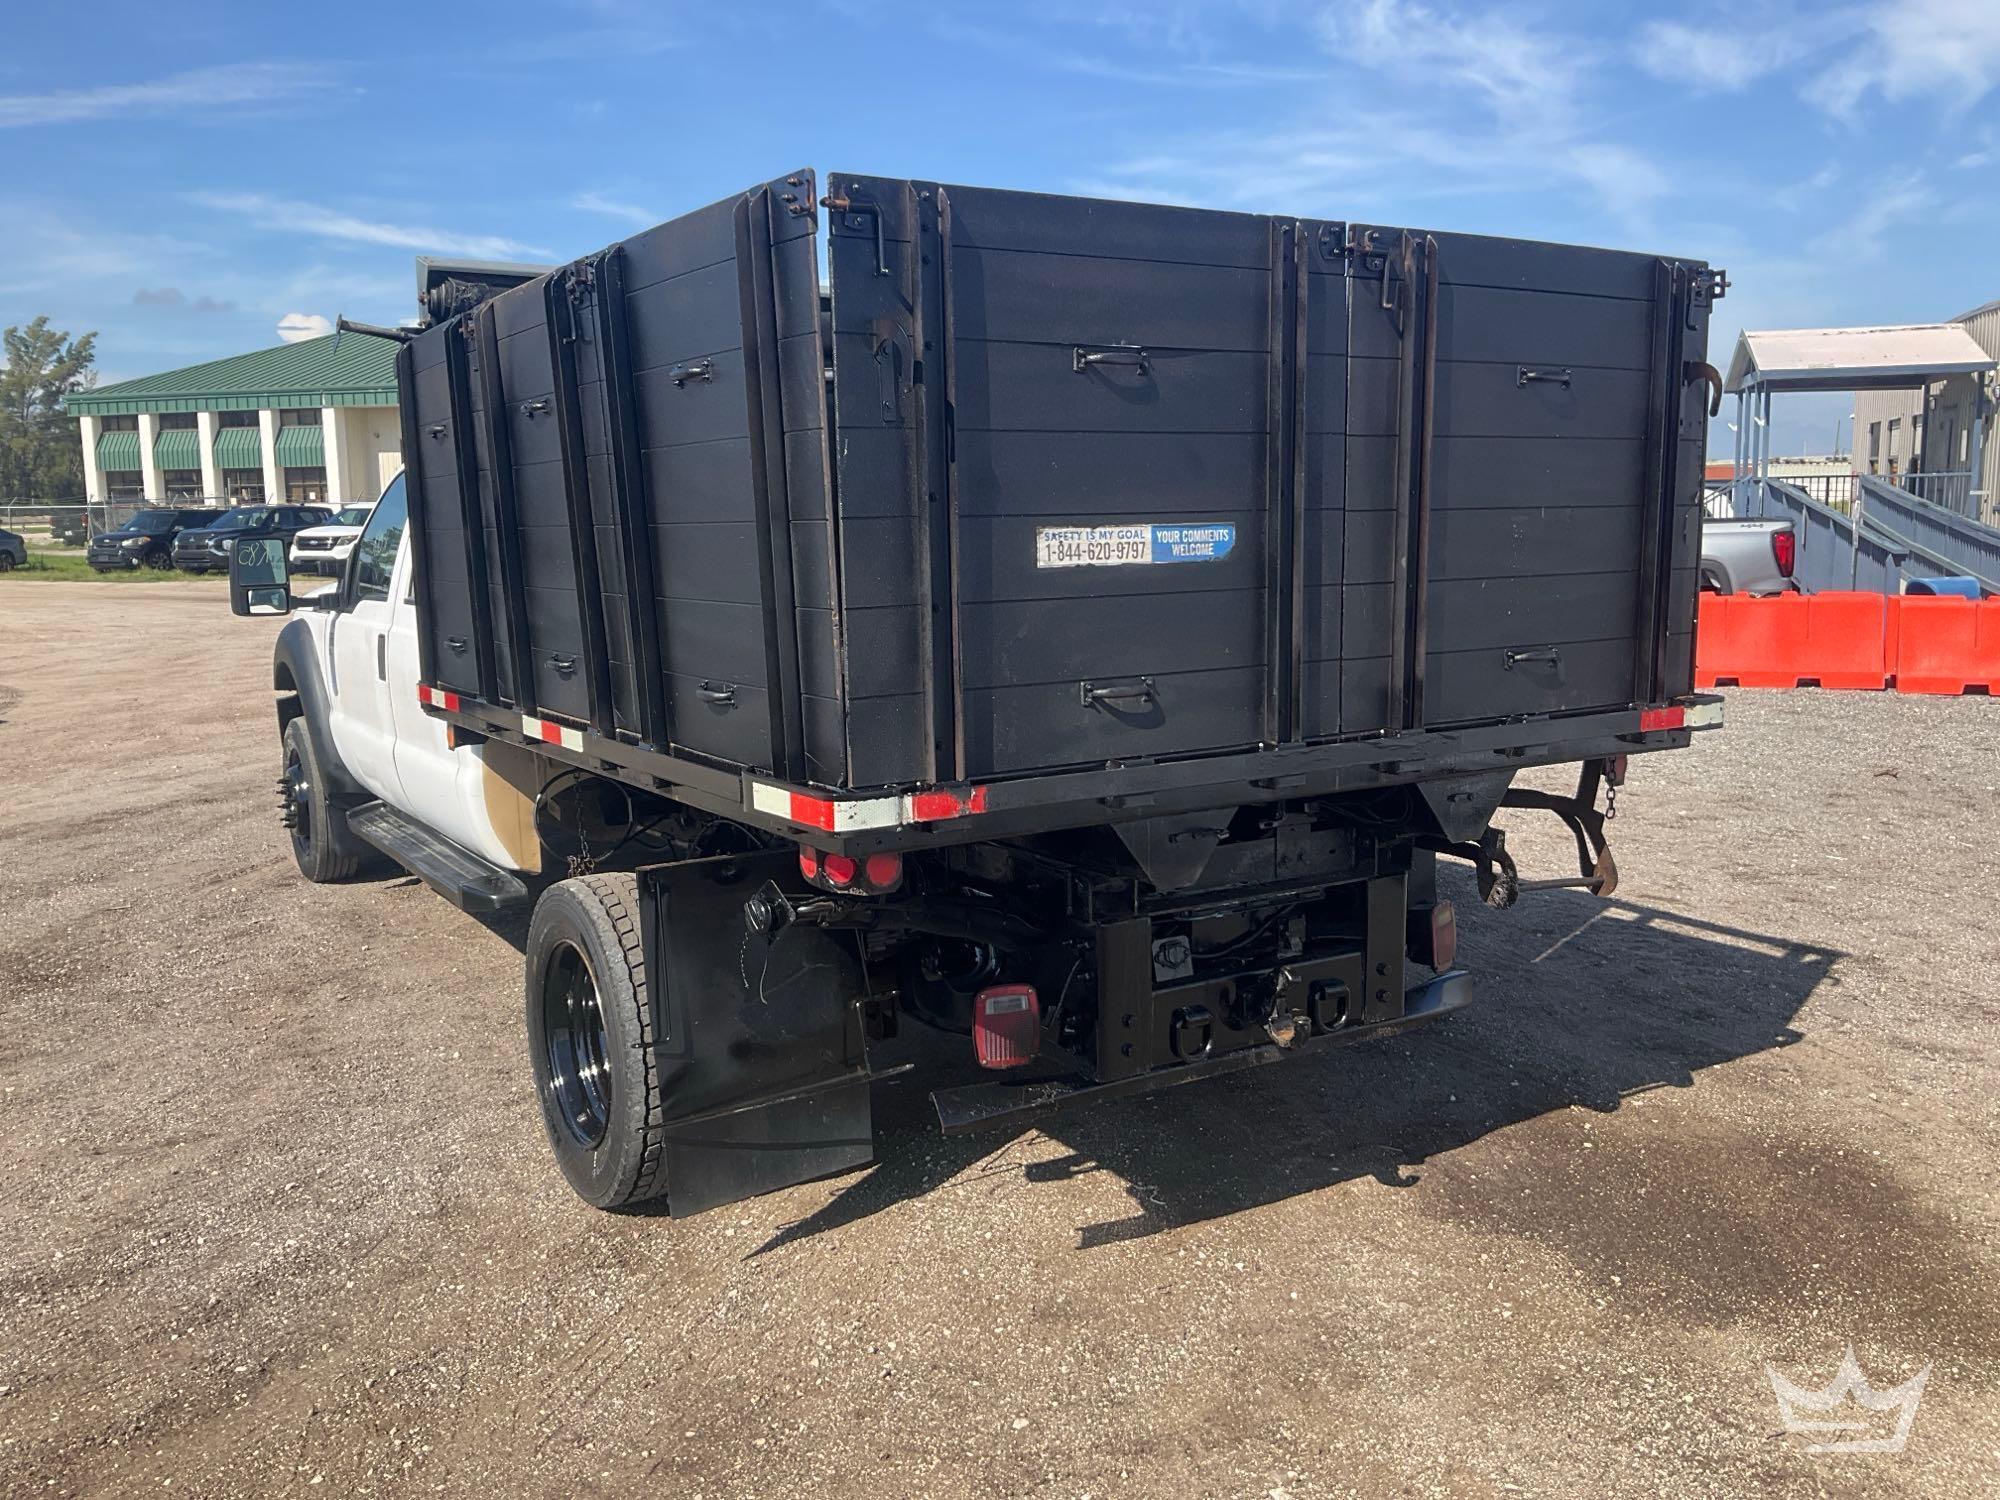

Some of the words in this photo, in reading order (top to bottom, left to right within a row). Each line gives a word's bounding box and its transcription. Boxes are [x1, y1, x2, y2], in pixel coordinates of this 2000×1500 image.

[1044, 531, 1083, 541] SAFETY
[1086, 530, 1096, 540] IS
[1099, 530, 1114, 540] MY
[1117, 529, 1145, 540] GOAL
[1156, 530, 1180, 543] YOUR
[1182, 529, 1229, 542] COMMENTS
[1045, 541, 1146, 562] 1-844-620-9797
[1171, 543, 1215, 556] WELCOME
